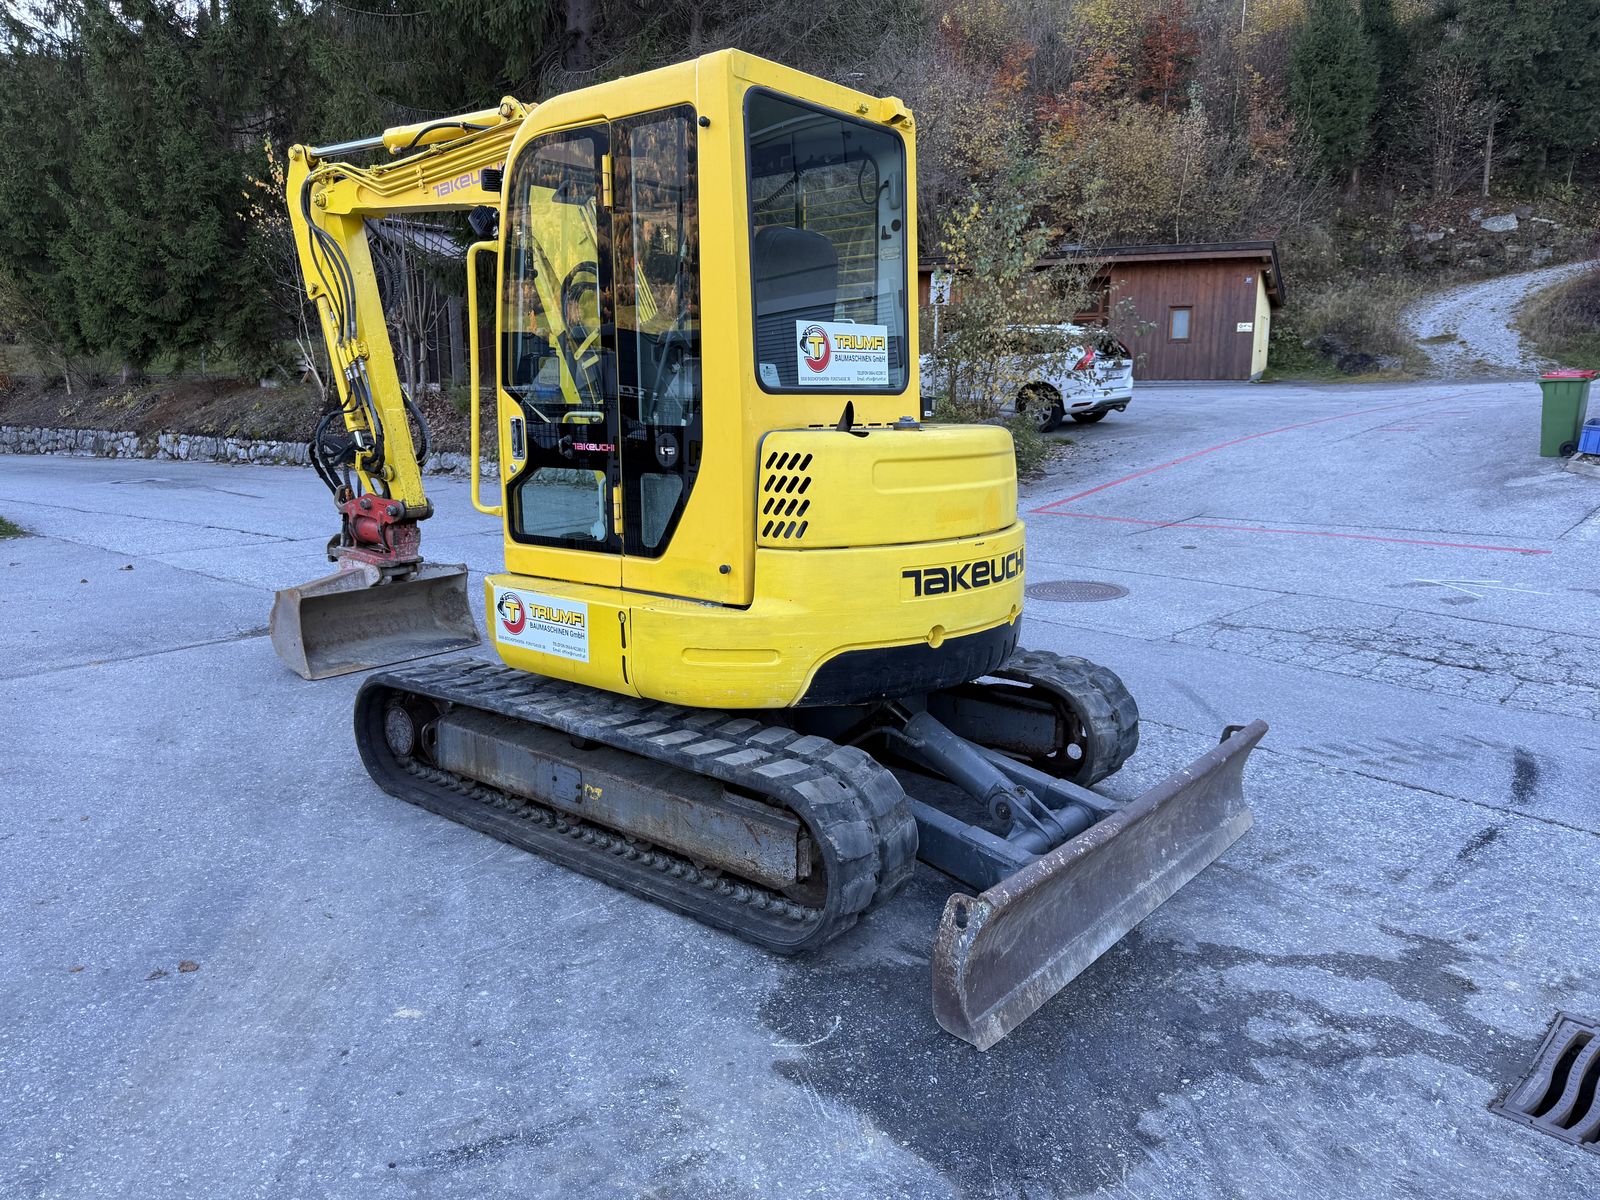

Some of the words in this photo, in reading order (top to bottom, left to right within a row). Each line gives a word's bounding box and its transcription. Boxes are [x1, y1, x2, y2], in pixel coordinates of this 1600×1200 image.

[834, 334, 886, 351] TRIUMFI
[835, 354, 872, 363] BAUMASCHINEN
[872, 355, 886, 363] GmbH
[572, 442, 616, 452] TAKEUCHI
[528, 603, 585, 628] TRIUMFI
[529, 621, 569, 637] BAUMASCHINEN
[569, 631, 585, 640] GmbH
